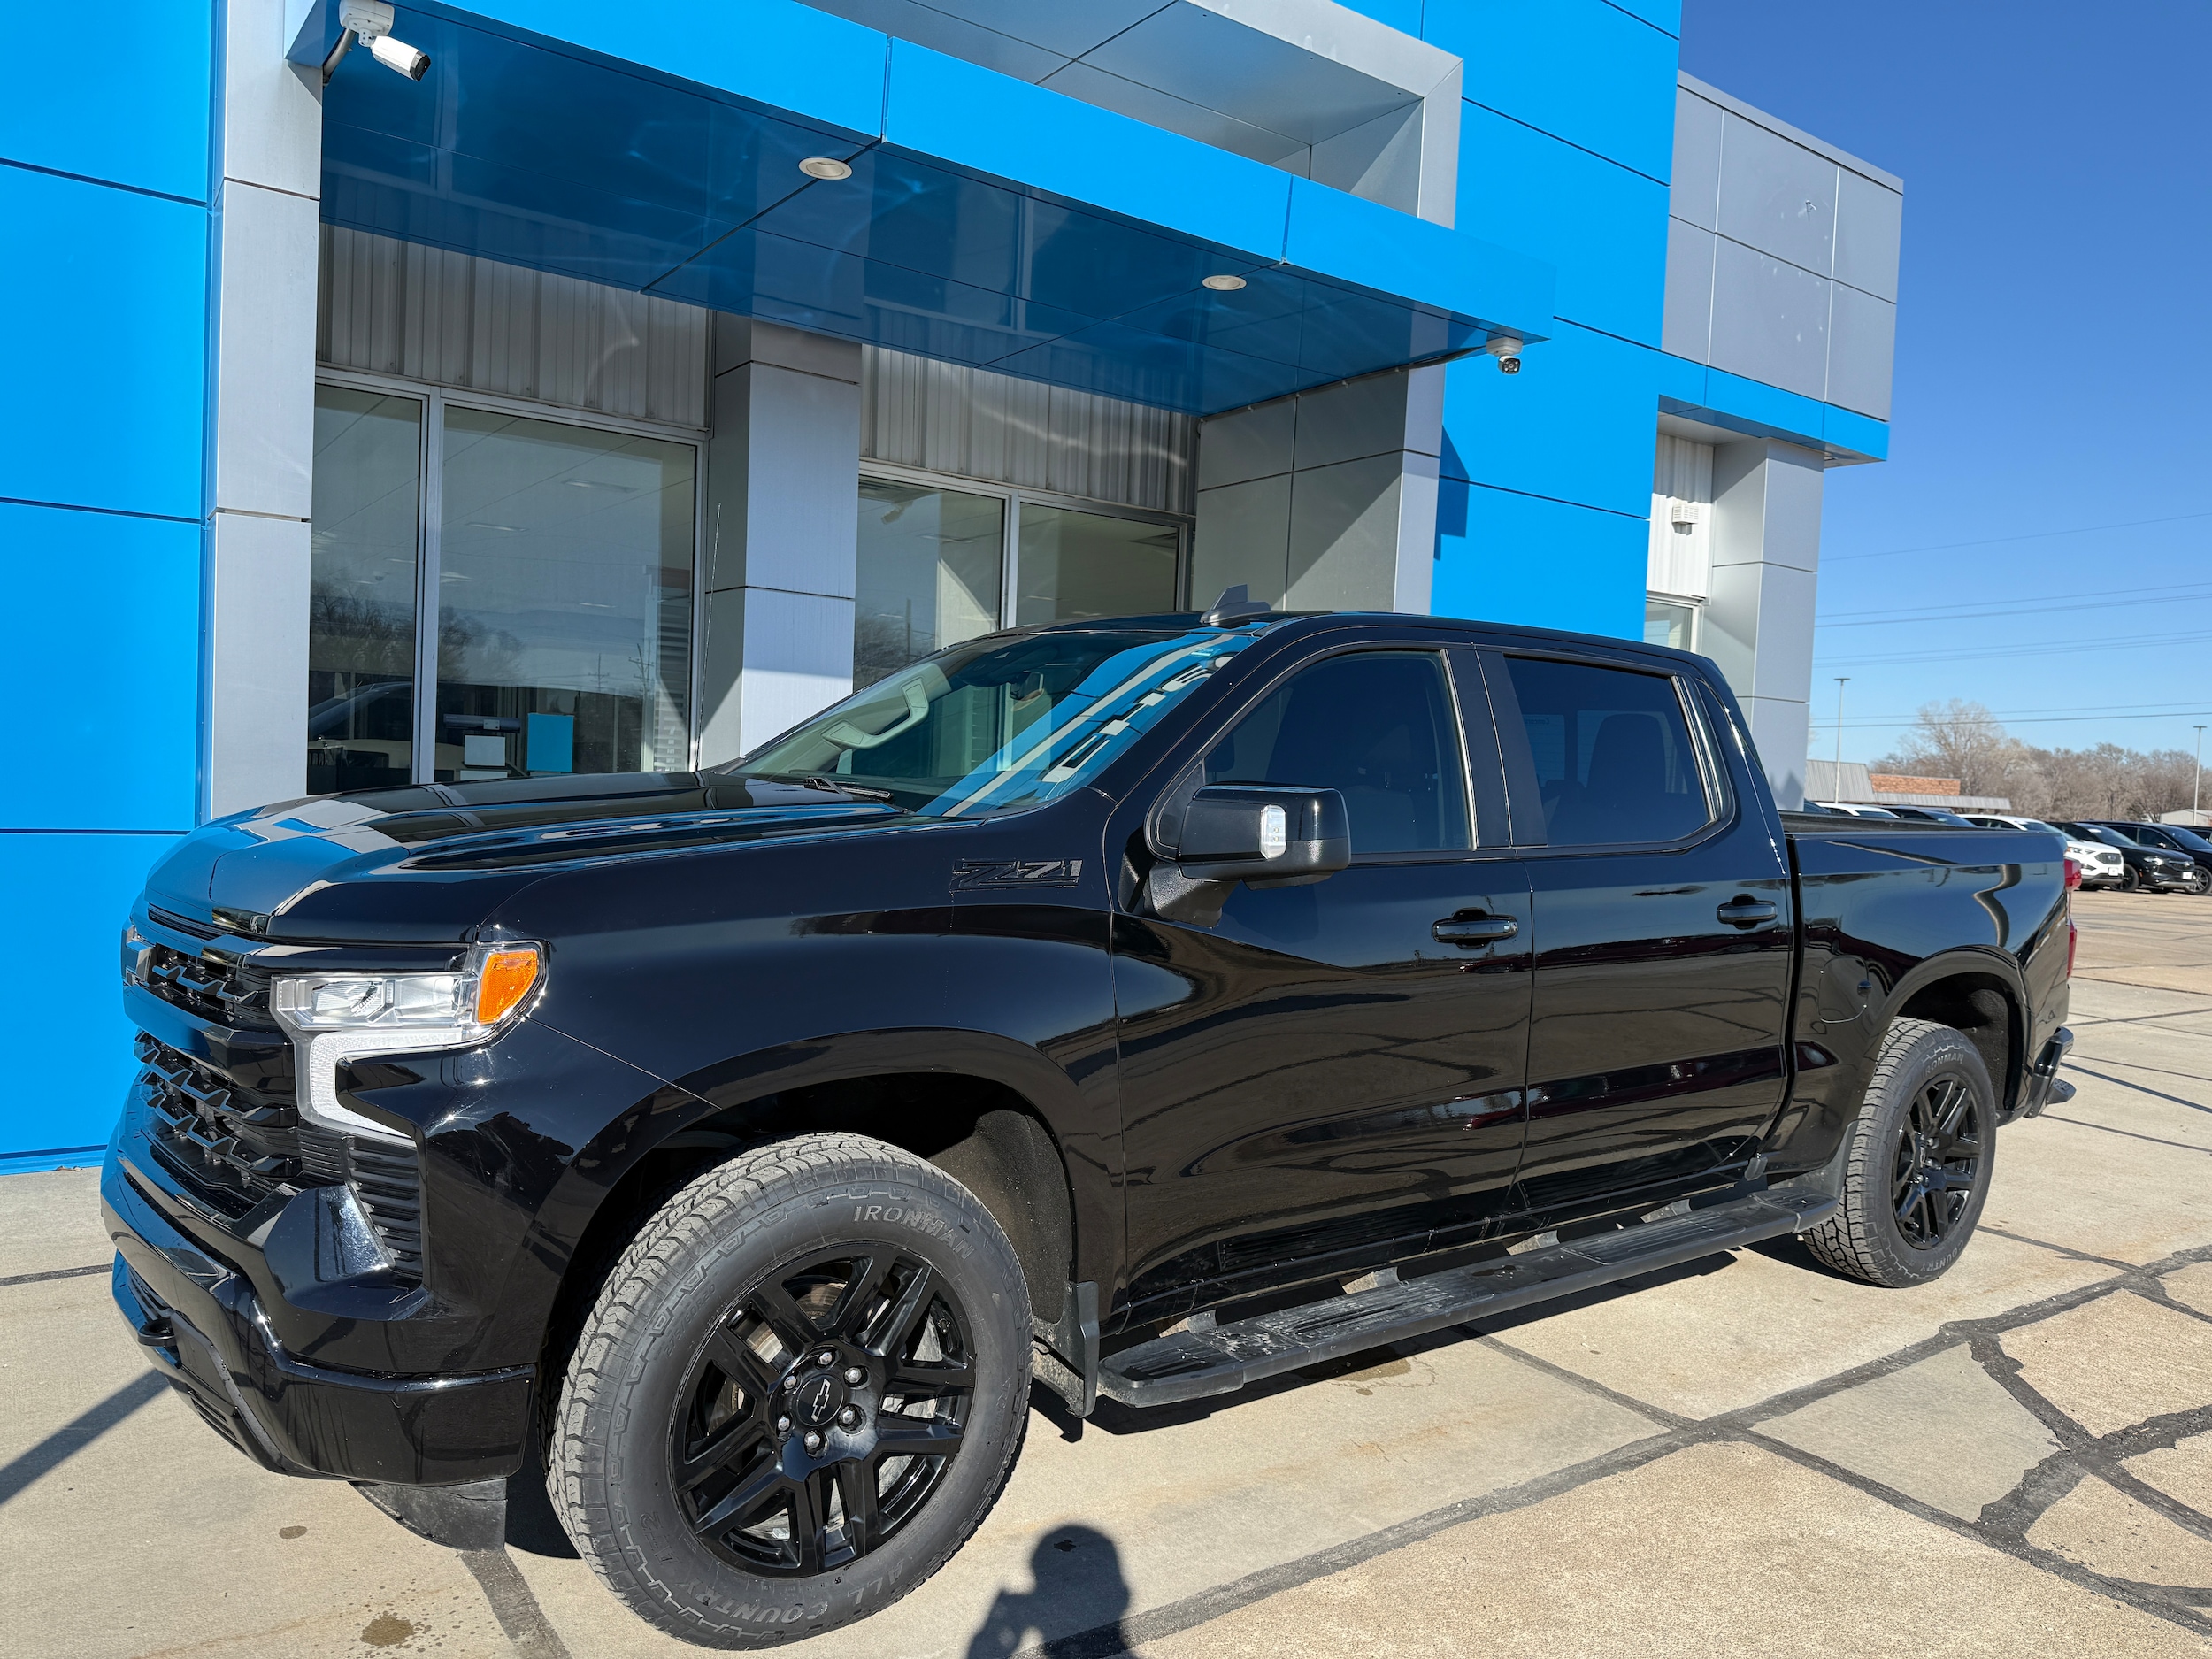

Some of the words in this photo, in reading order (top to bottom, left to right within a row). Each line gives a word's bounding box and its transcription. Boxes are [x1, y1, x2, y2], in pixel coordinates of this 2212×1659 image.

[949, 859, 1083, 892] Z71
[854, 1205, 974, 1260] IRONMAN
[1920, 1240, 1964, 1271] COUNTRY
[677, 1578, 829, 1624] COUNTRY
[847, 1558, 904, 1606] ALL
